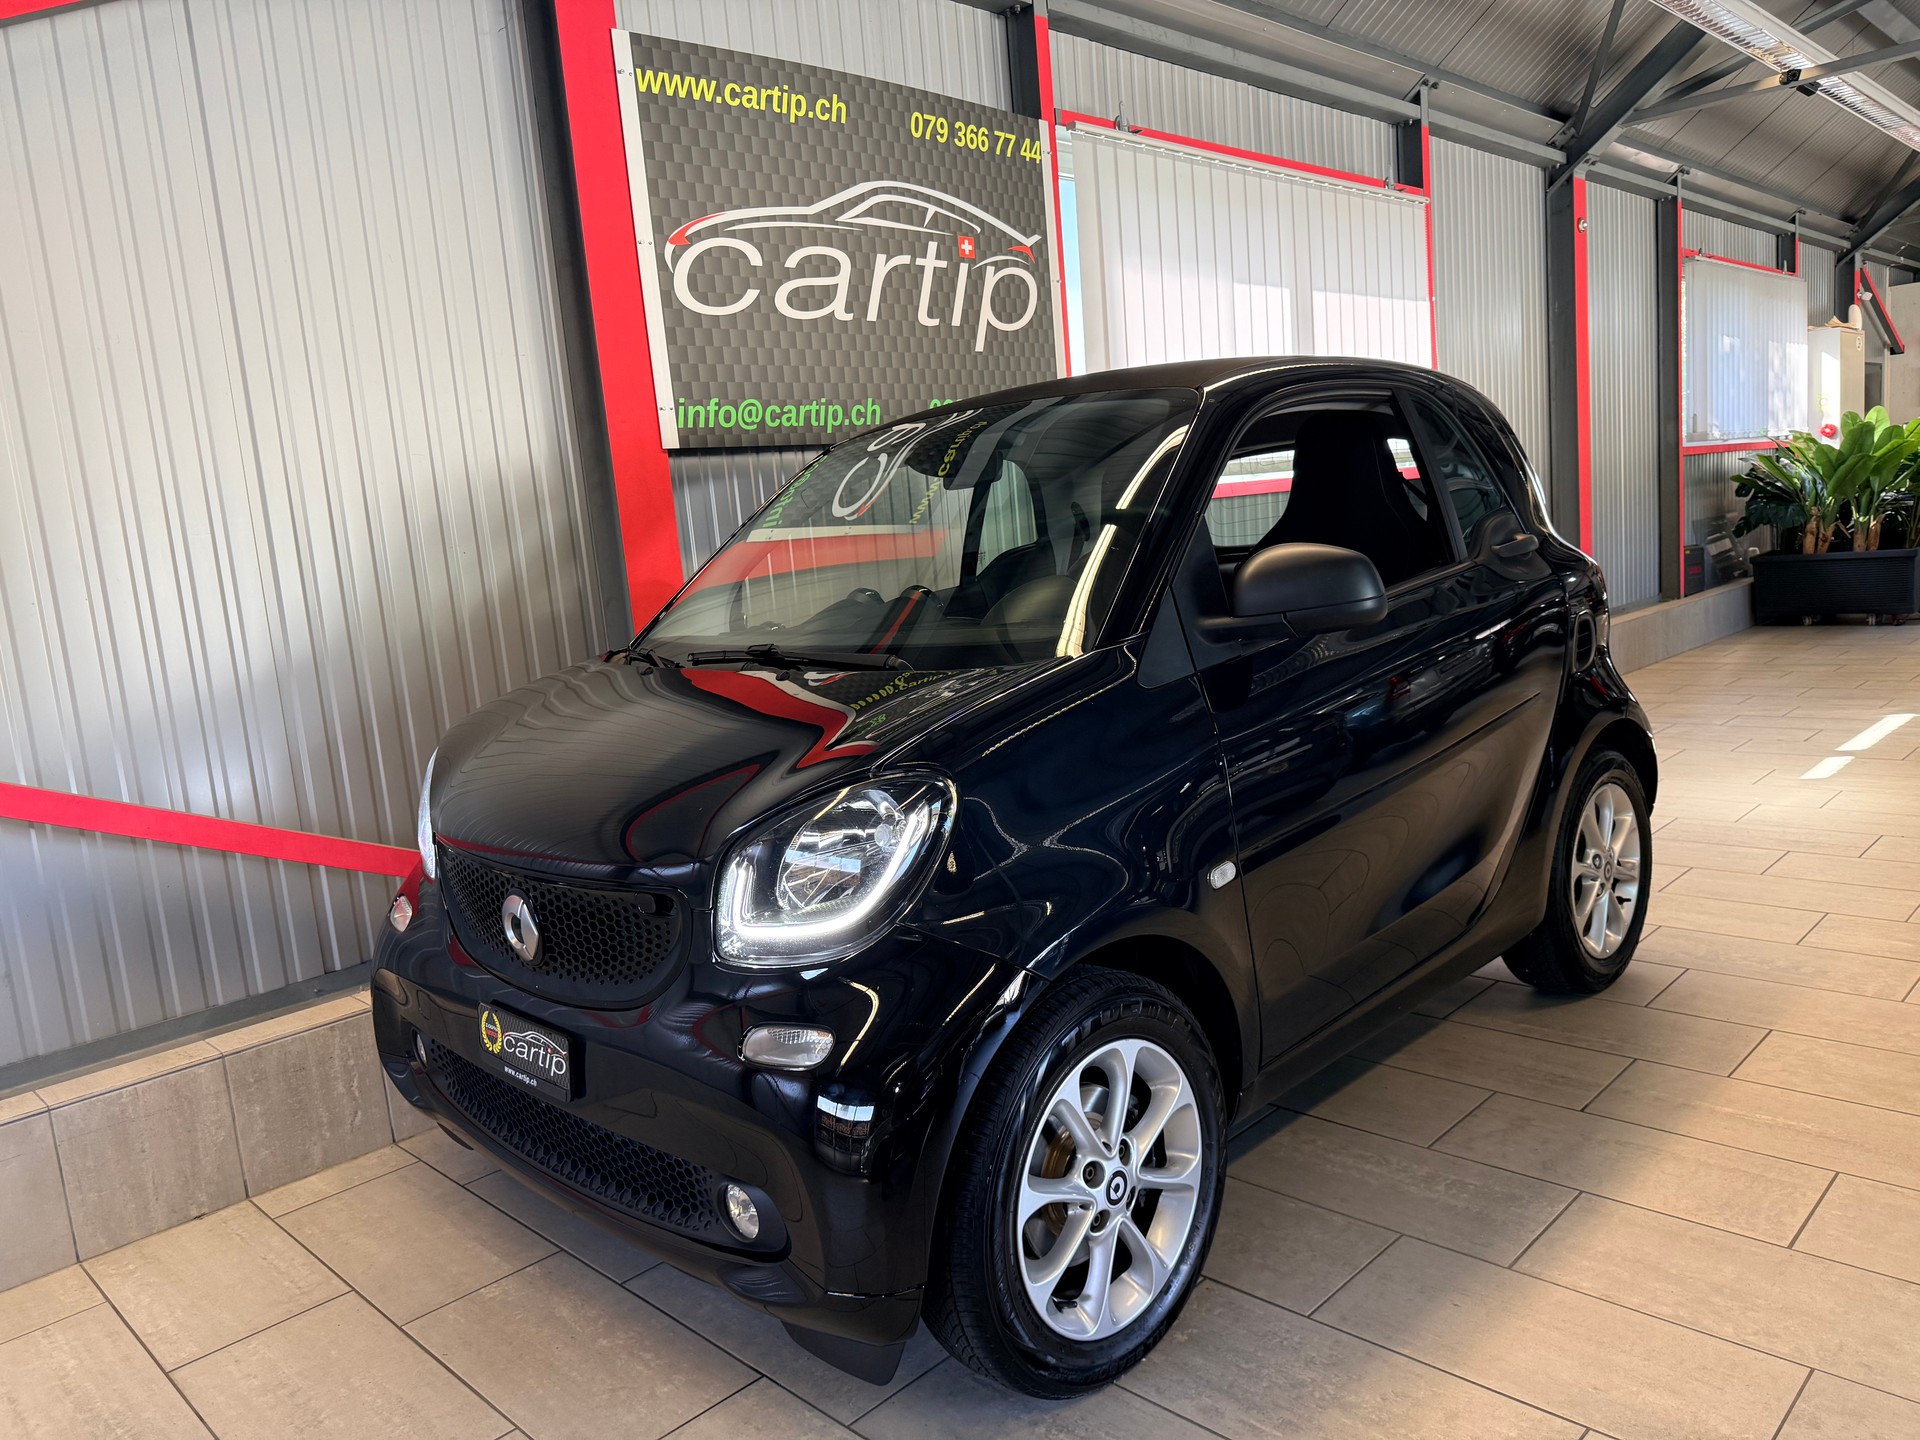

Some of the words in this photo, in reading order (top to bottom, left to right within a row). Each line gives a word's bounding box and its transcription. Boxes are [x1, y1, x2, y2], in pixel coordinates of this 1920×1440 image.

[635, 68, 847, 124] www.cartip.ch
[910, 111, 949, 144] 079
[954, 121, 989, 153] 366
[994, 130, 1017, 158] 77
[1019, 138, 1042, 164] 44
[673, 236, 1038, 352] cartip
[677, 398, 881, 433] info@cartip.ch
[503, 1036, 566, 1077] cartip
[504, 1065, 538, 1087] www.cartip.ch
